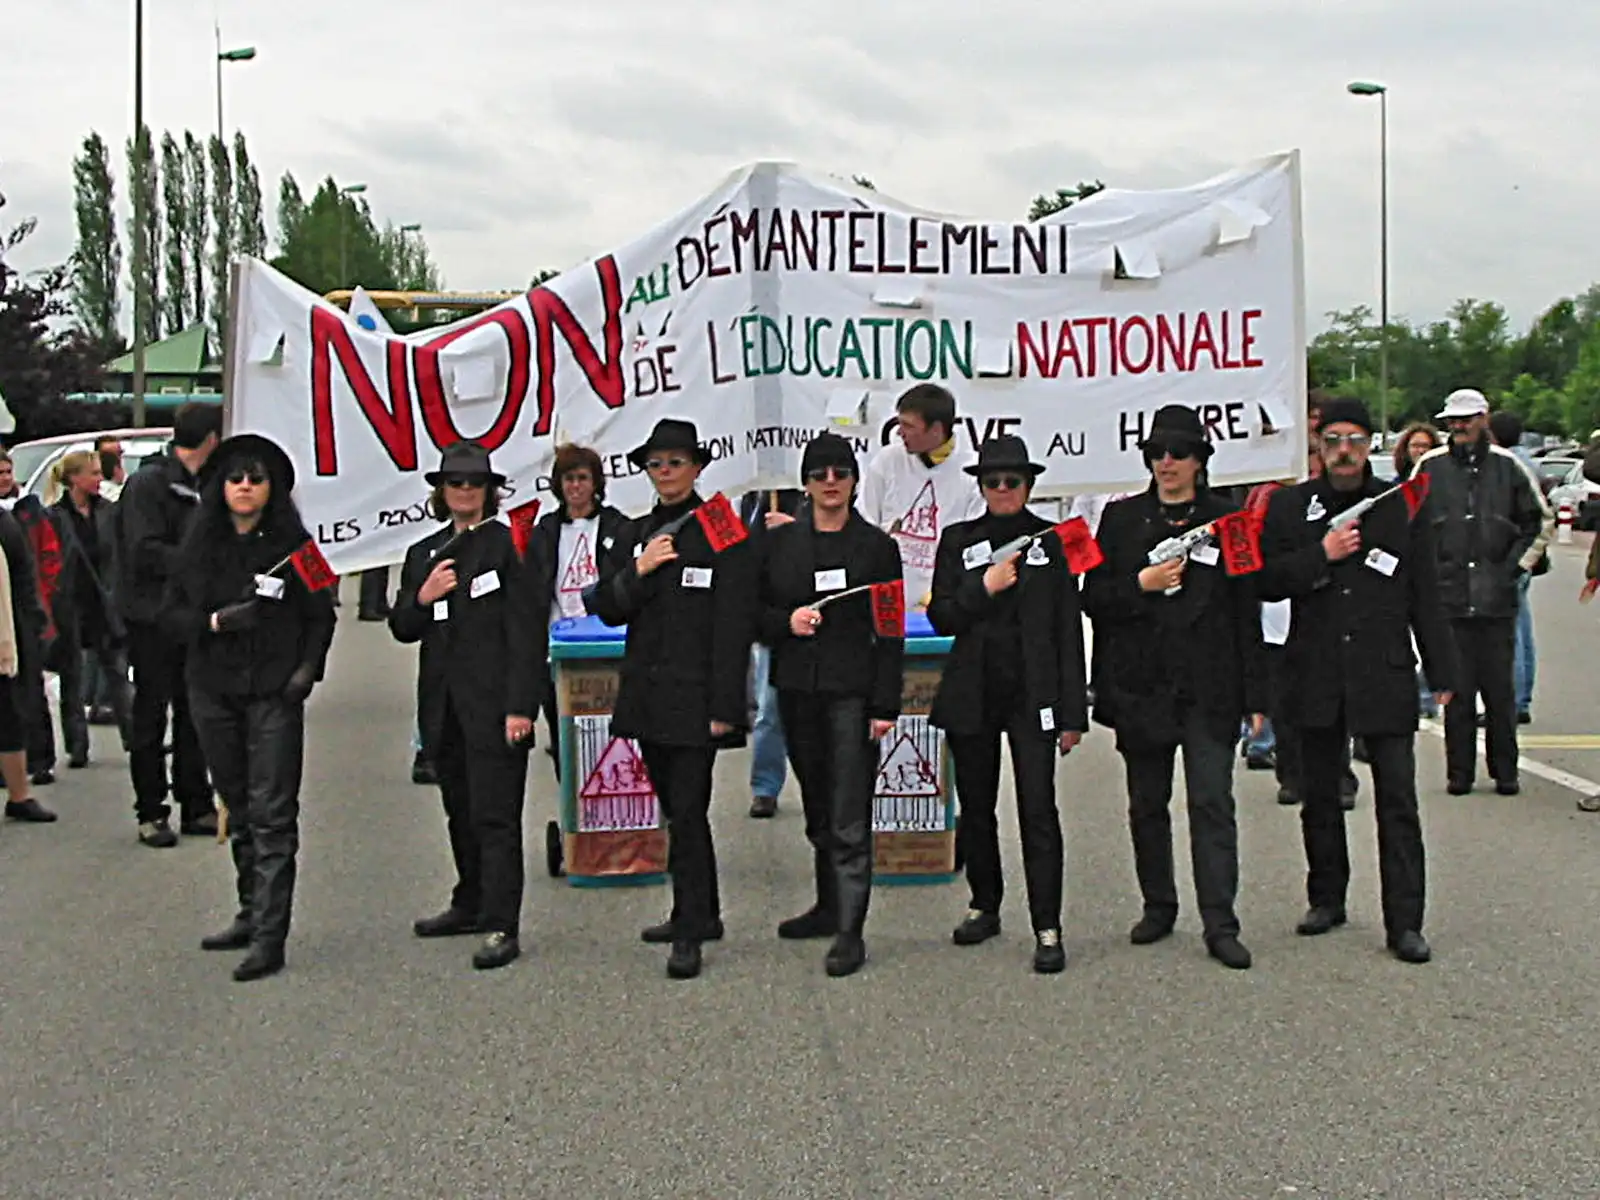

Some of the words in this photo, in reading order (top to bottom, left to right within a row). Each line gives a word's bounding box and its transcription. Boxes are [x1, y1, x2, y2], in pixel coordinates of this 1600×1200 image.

[625, 262, 671, 314] AU
[311, 253, 625, 476] NON
[708, 305, 974, 385] L'ÉDUCATION
[1017, 309, 1264, 379] NATIONALE
[318, 518, 361, 544] LES
[1047, 432, 1085, 457] AU
[1120, 402, 1249, 452] HRE
